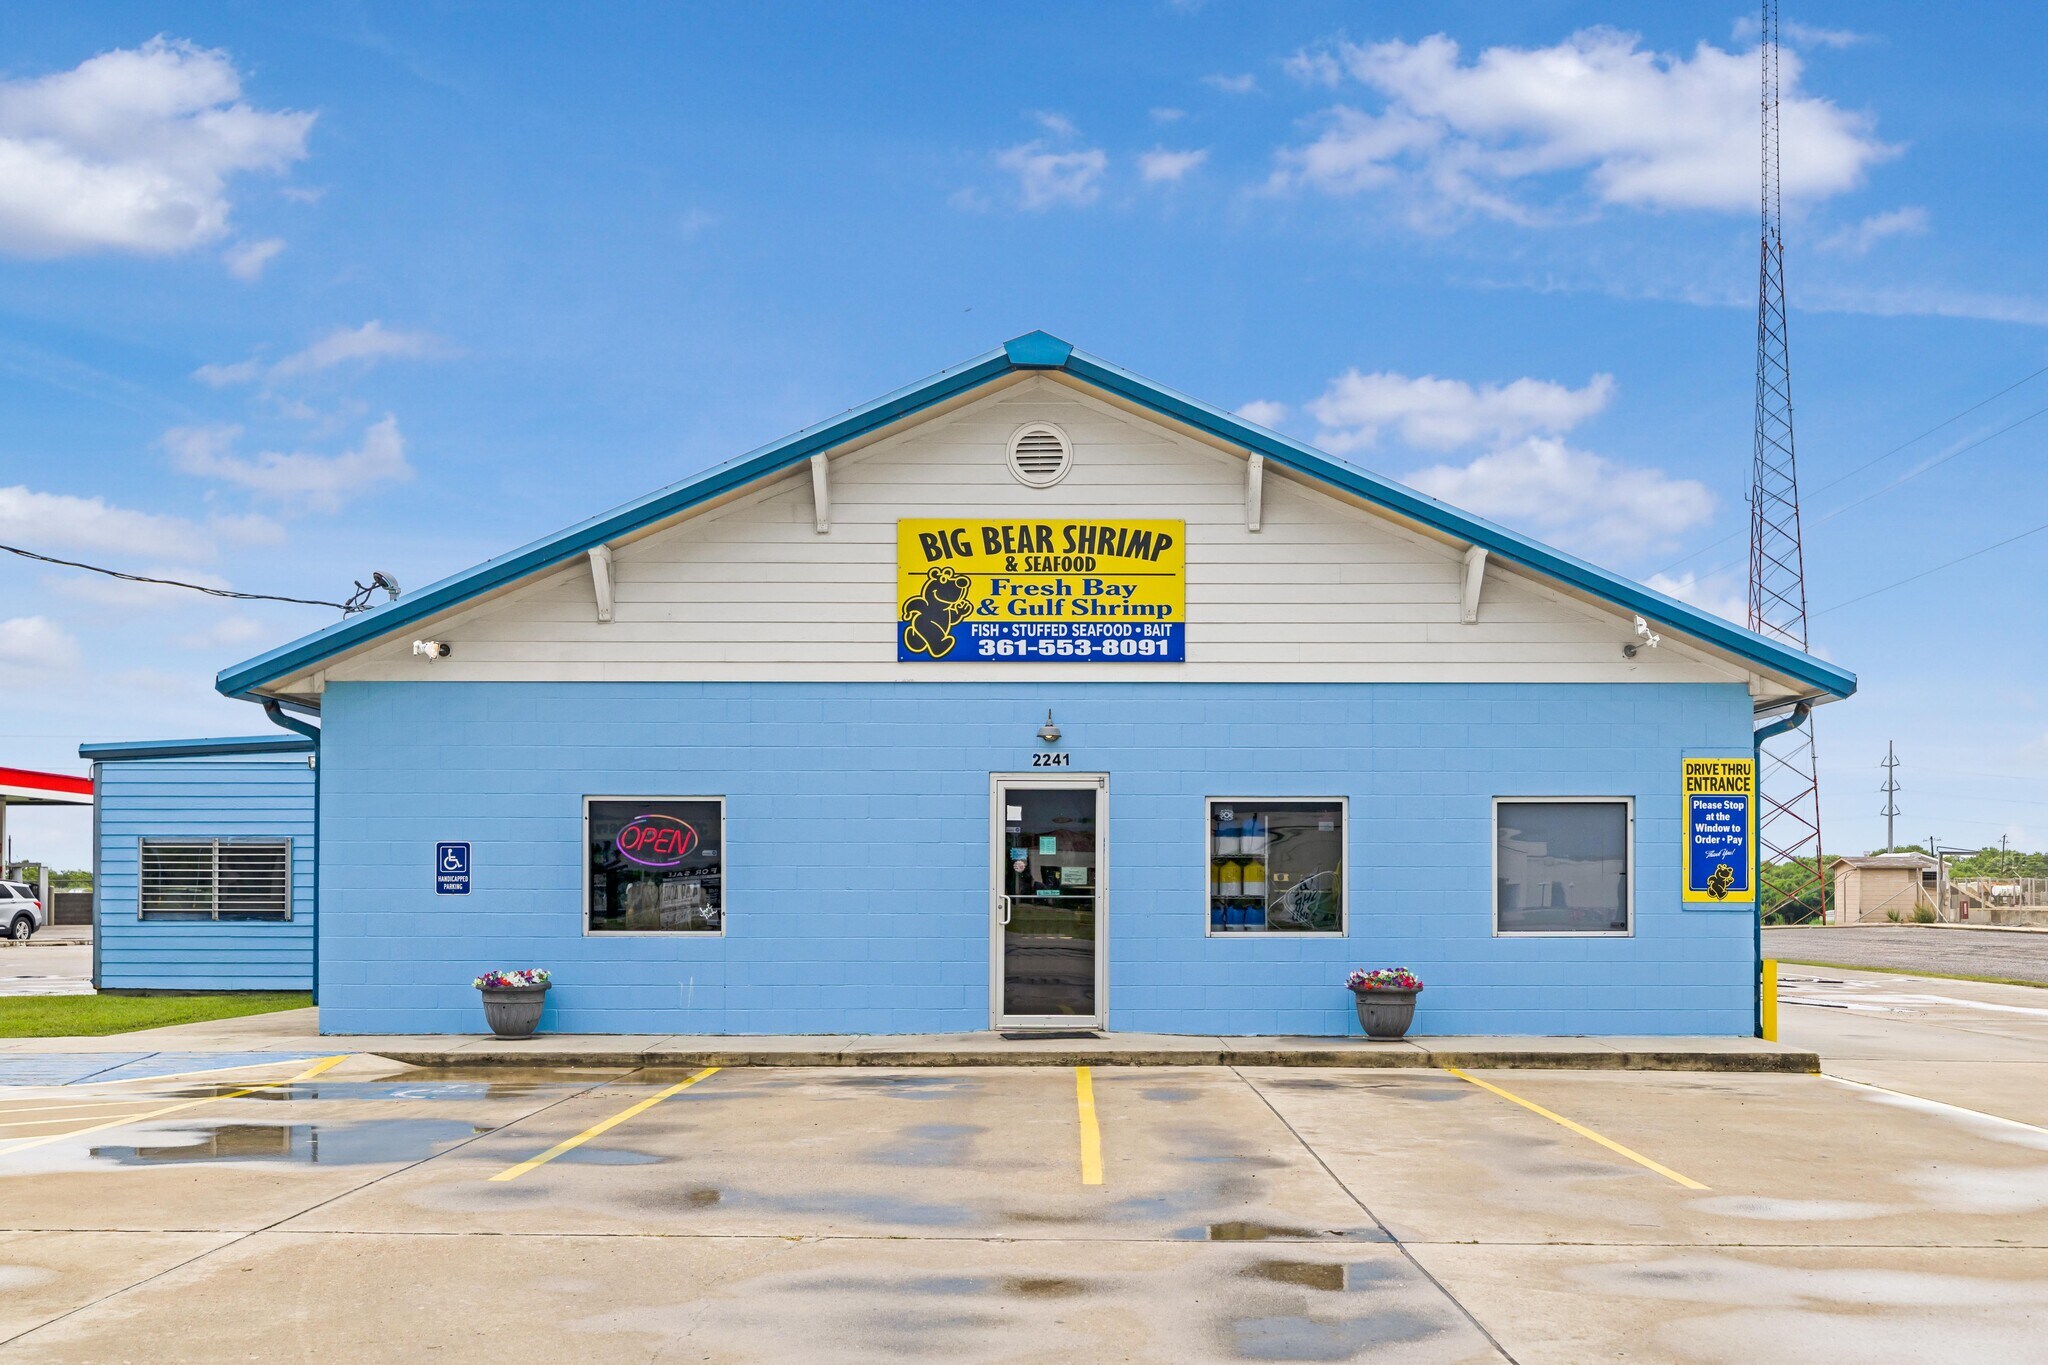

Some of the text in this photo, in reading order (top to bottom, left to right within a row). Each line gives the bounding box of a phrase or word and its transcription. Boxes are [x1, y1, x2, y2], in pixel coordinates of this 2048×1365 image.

[919, 524, 1172, 562] BIG BEAR SHRIMP
[1005, 556, 1096, 572] & SEAFOOD
[990, 578, 1137, 598] Fresh Bay
[976, 598, 1172, 619] & Gulf Shrimp
[971, 624, 1172, 637] FISH STUFFED SEAFOOD BAIT
[978, 639, 1169, 656] 361-553-8091
[1032, 753, 1069, 766] 2241
[1686, 763, 1751, 775] DRIVE THRU
[1686, 777, 1751, 791] ENTRANCE
[1693, 800, 1744, 811] Please Stop
[1706, 812, 1730, 821] at the
[1695, 823, 1741, 833] Window to
[621, 826, 691, 854] OPEN
[1695, 834, 1742, 846] Order Pay
